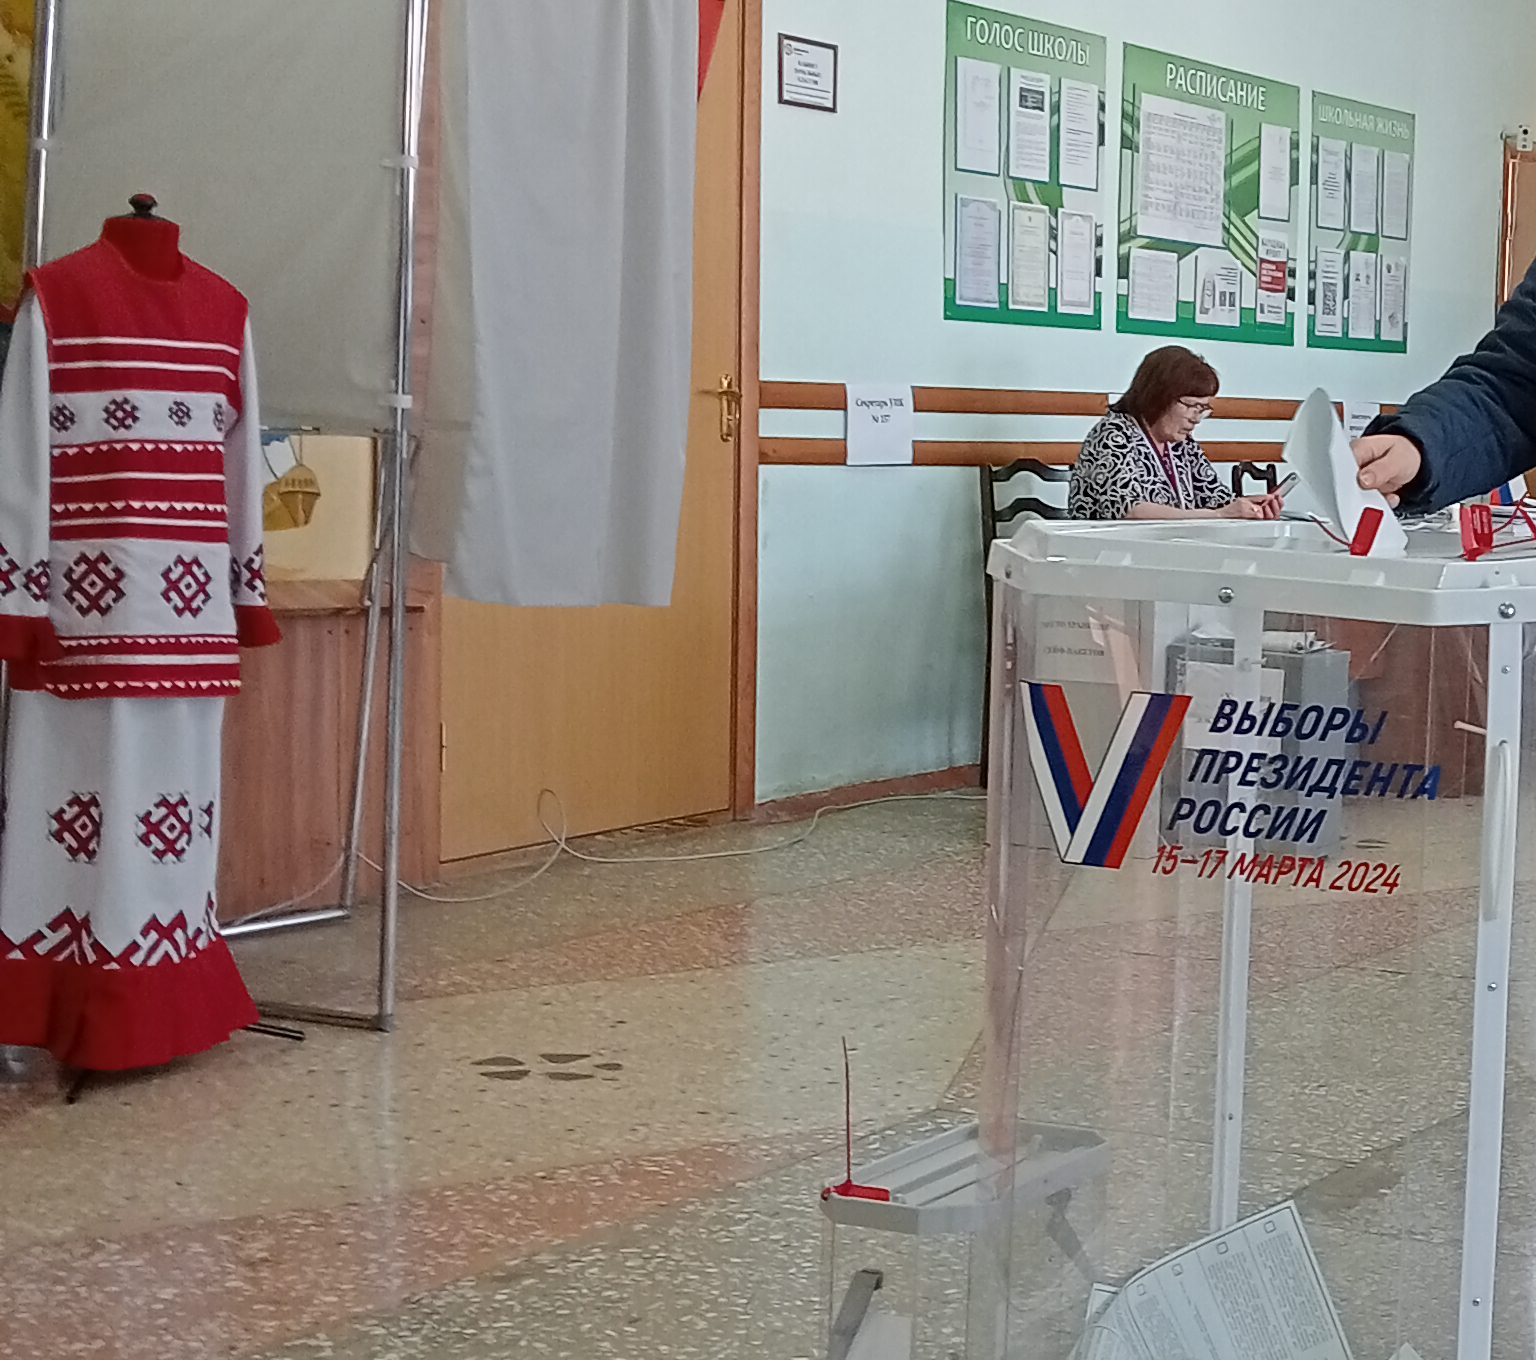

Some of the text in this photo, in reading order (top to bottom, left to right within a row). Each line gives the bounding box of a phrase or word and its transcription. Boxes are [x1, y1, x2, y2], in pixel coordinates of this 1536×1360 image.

[966, 15, 1090, 66] ГОЛОС ШКОЛЫ
[1166, 62, 1267, 111] РАСПИСАНИЕ
[1208, 698, 1388, 745] ВЫБОРЫ
[1188, 747, 1441, 800] ПРЕЗИДЕНТА
[1166, 797, 1328, 843] РОССИИ
[1227, 852, 1325, 889] МАРТА
[1329, 860, 1401, 895] 2024
